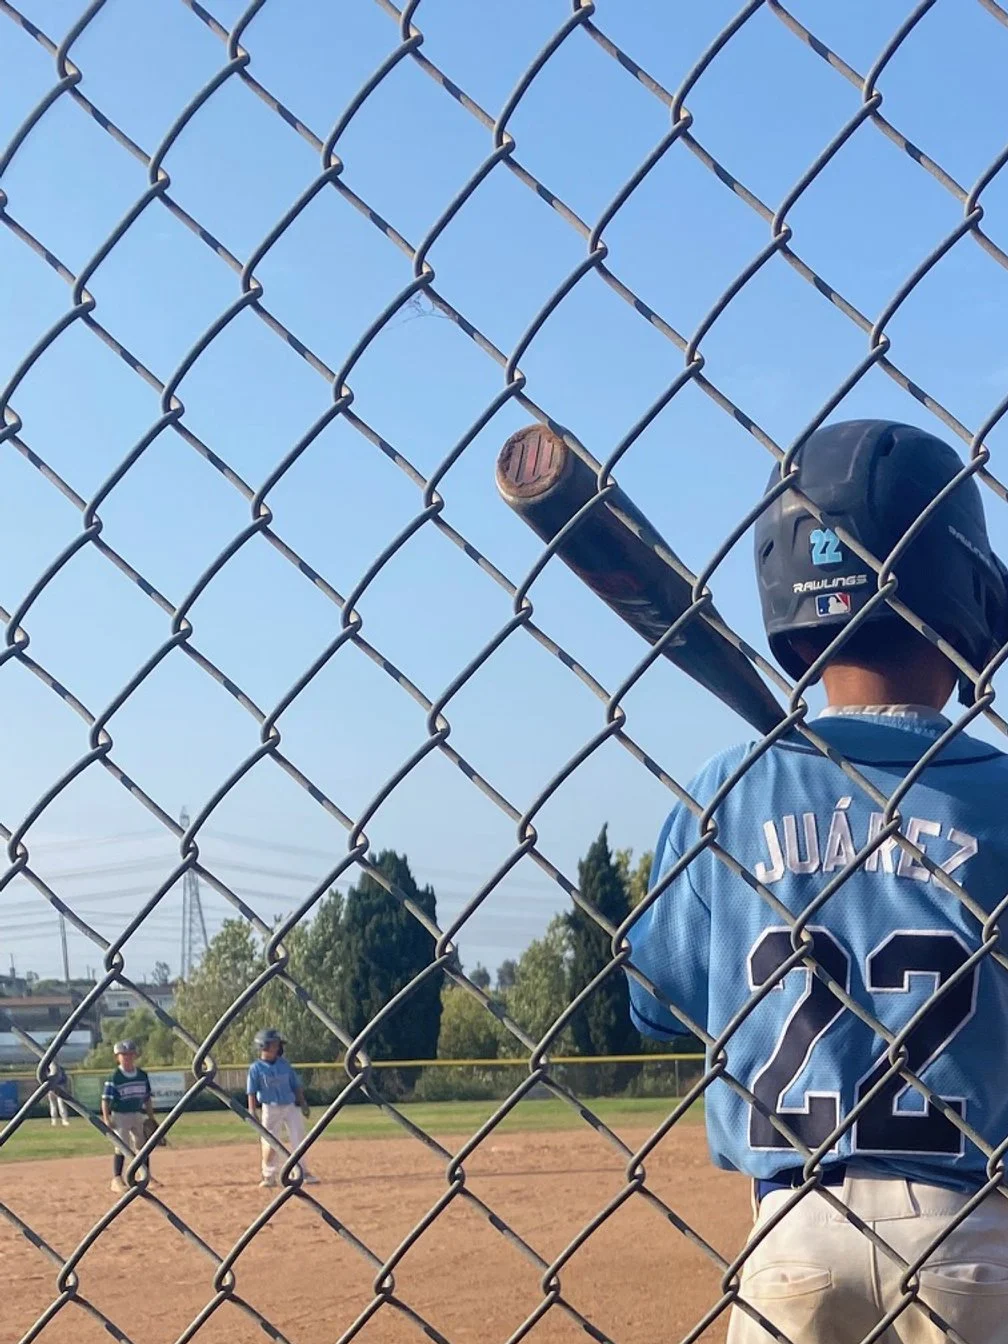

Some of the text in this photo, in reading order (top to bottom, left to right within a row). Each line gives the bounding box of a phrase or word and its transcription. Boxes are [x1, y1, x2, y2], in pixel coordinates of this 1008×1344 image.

[809, 528, 843, 565] 22
[793, 574, 867, 593] RAWLINGS
[754, 796, 979, 893] JUÁREZ
[746, 924, 982, 1156] 22
